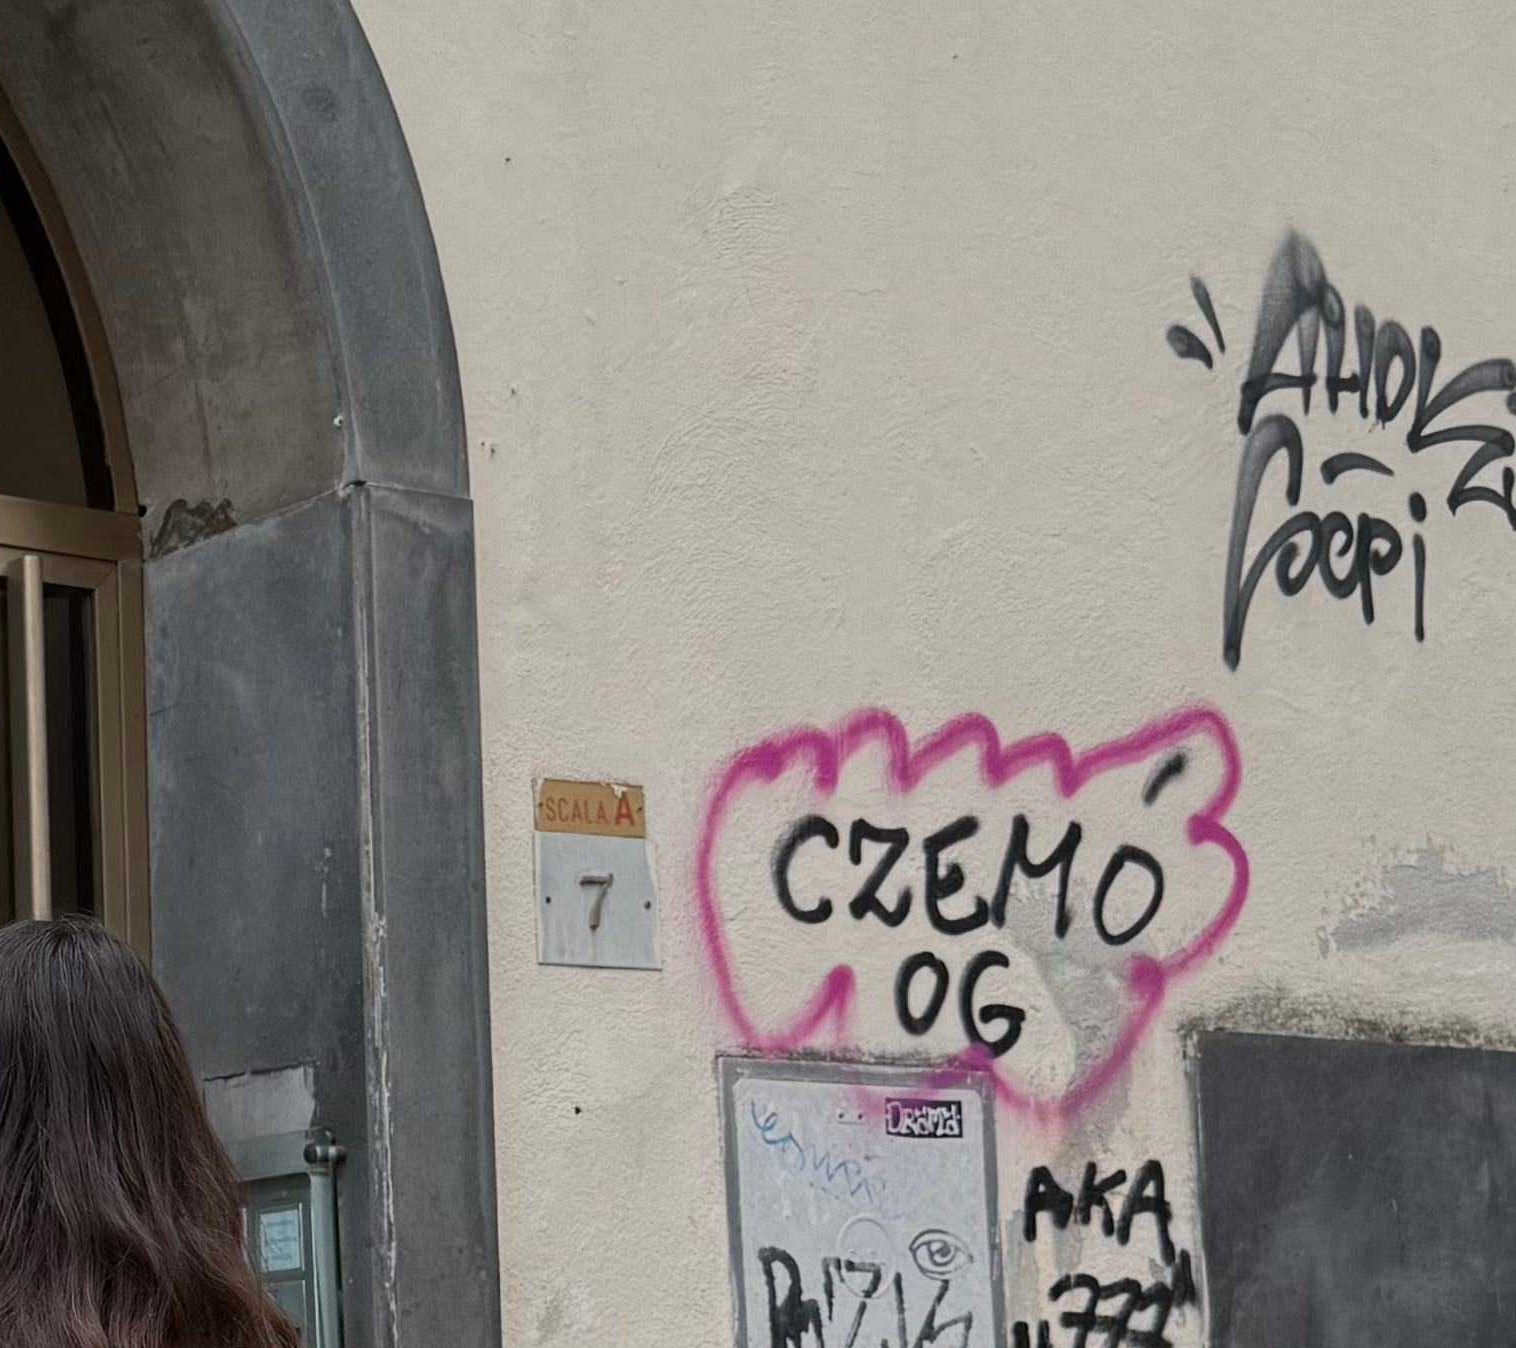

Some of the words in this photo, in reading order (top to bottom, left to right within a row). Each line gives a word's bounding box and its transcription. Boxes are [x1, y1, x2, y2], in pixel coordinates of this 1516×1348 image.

[546, 797, 609, 825] SCALA
[614, 791, 636, 827] A
[579, 871, 614, 931] 7
[894, 951, 1026, 1058] OG
[1024, 1159, 1176, 1268] AKA
